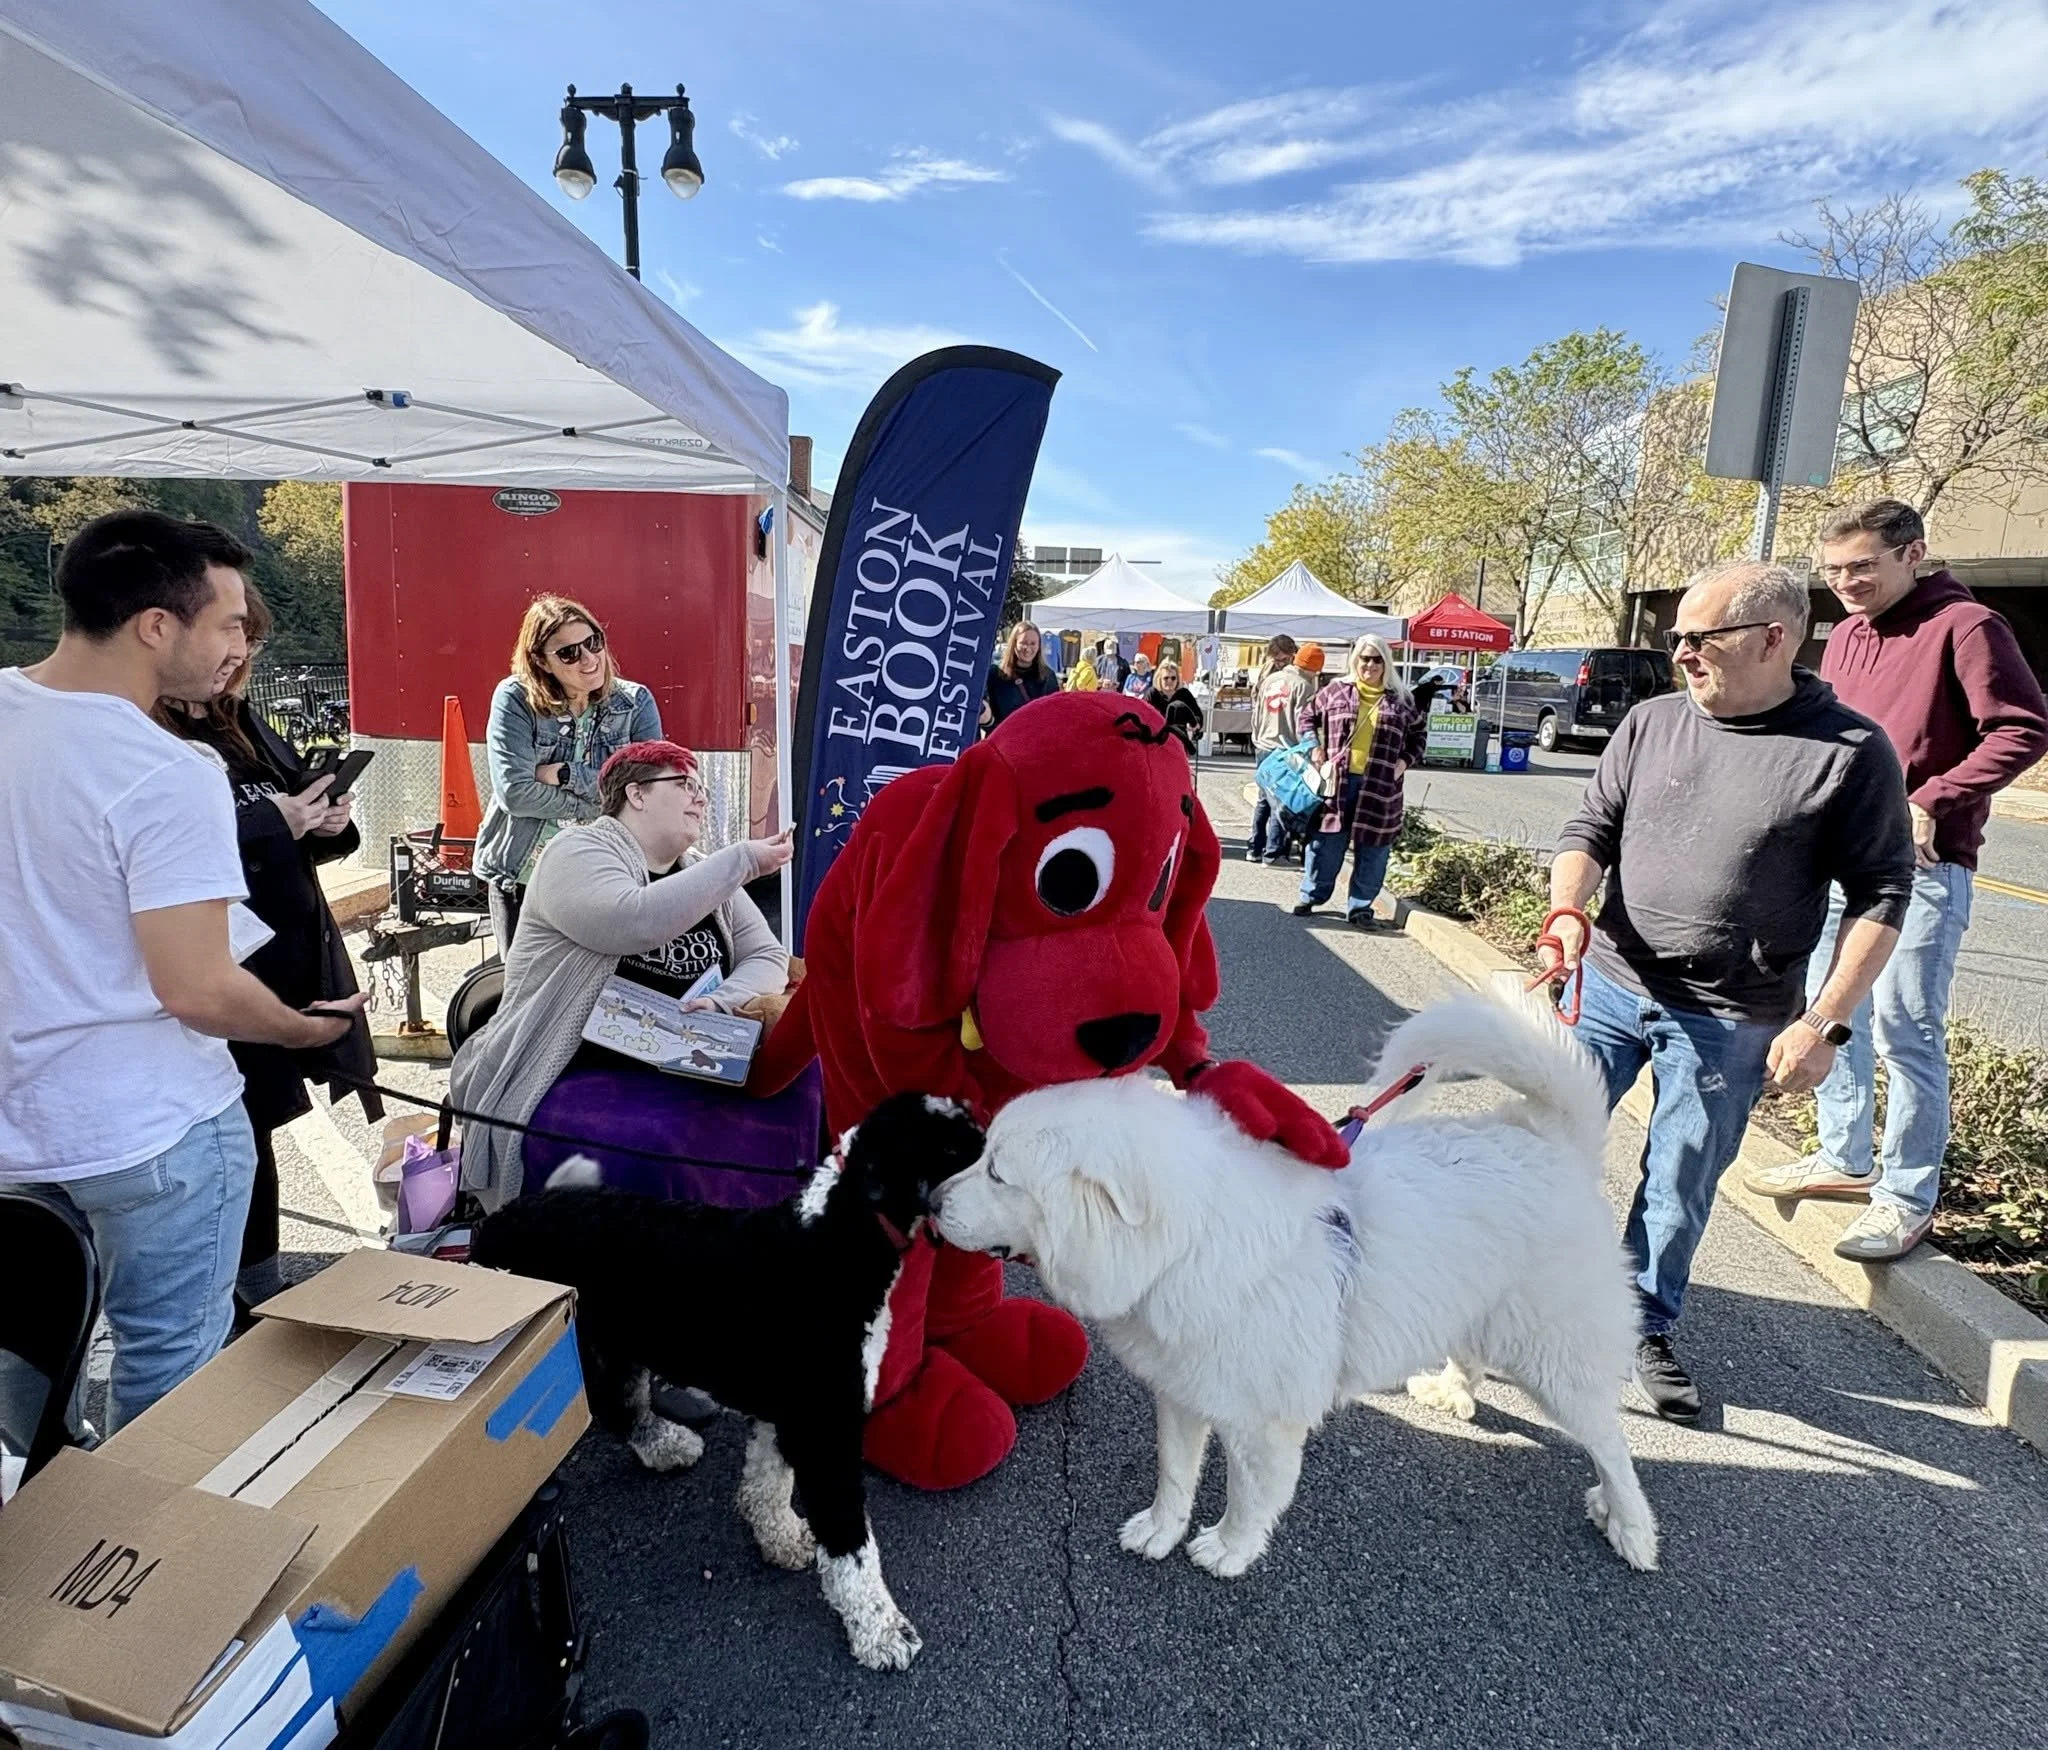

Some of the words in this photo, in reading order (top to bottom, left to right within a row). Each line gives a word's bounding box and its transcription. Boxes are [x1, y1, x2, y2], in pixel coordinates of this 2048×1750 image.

[828, 496, 911, 744] EASTON
[867, 513, 969, 756] BOOK
[926, 533, 1003, 764] FESTIVAL
[1429, 628, 1448, 638] EBT
[1450, 630, 1494, 642] STATION
[1431, 716, 1451, 724] SHOP
[1431, 723, 1455, 731] WITH
[1456, 724, 1473, 732] EBT
[433, 875, 471, 888] Durling
[377, 1280, 461, 1309] MD4
[48, 1539, 162, 1619] MD4
